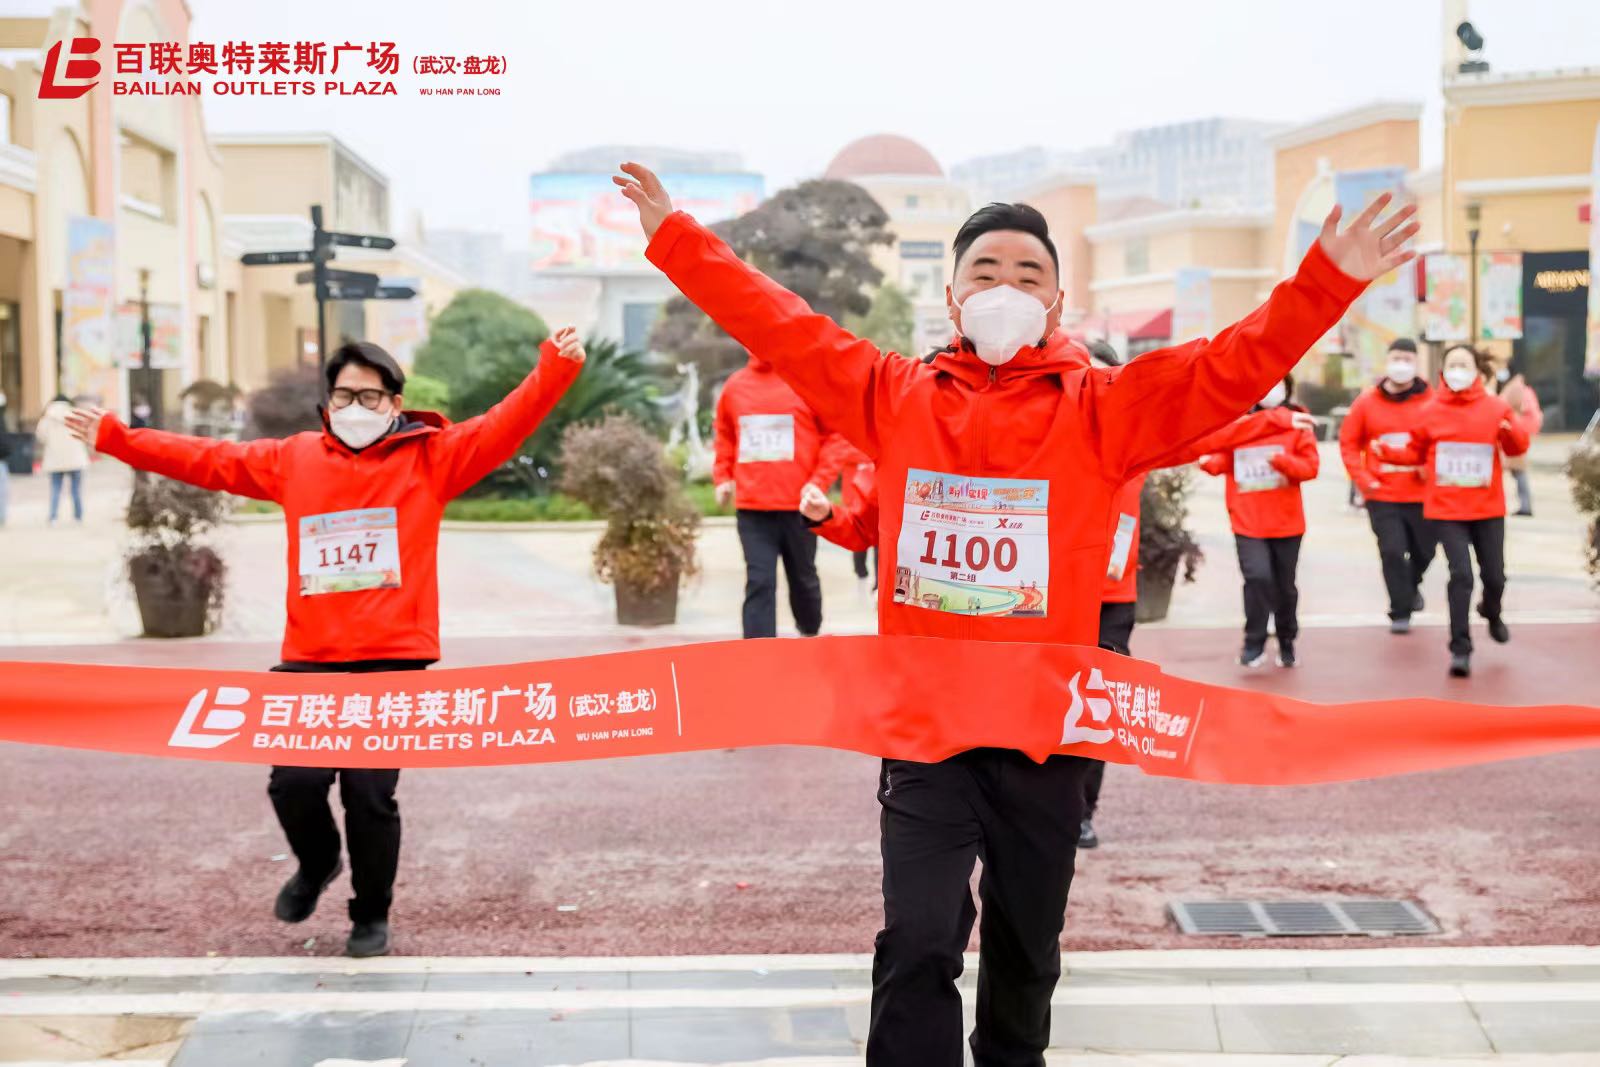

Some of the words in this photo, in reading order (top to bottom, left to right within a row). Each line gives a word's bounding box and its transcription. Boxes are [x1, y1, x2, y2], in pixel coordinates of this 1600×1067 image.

[319, 542, 378, 567] 1147
[919, 530, 1018, 573] 1100
[950, 571, 977, 582] 第二组
[260, 683, 557, 729] 百联奥特莱斯广场
[252, 732, 352, 751] BAILIAN
[363, 733, 473, 751] OUTLETS
[481, 728, 556, 748] PLAZA
[576, 733, 590, 742] WU
[592, 731, 609, 741] HAN
[612, 730, 629, 740] PAN
[631, 727, 653, 738] LONG
